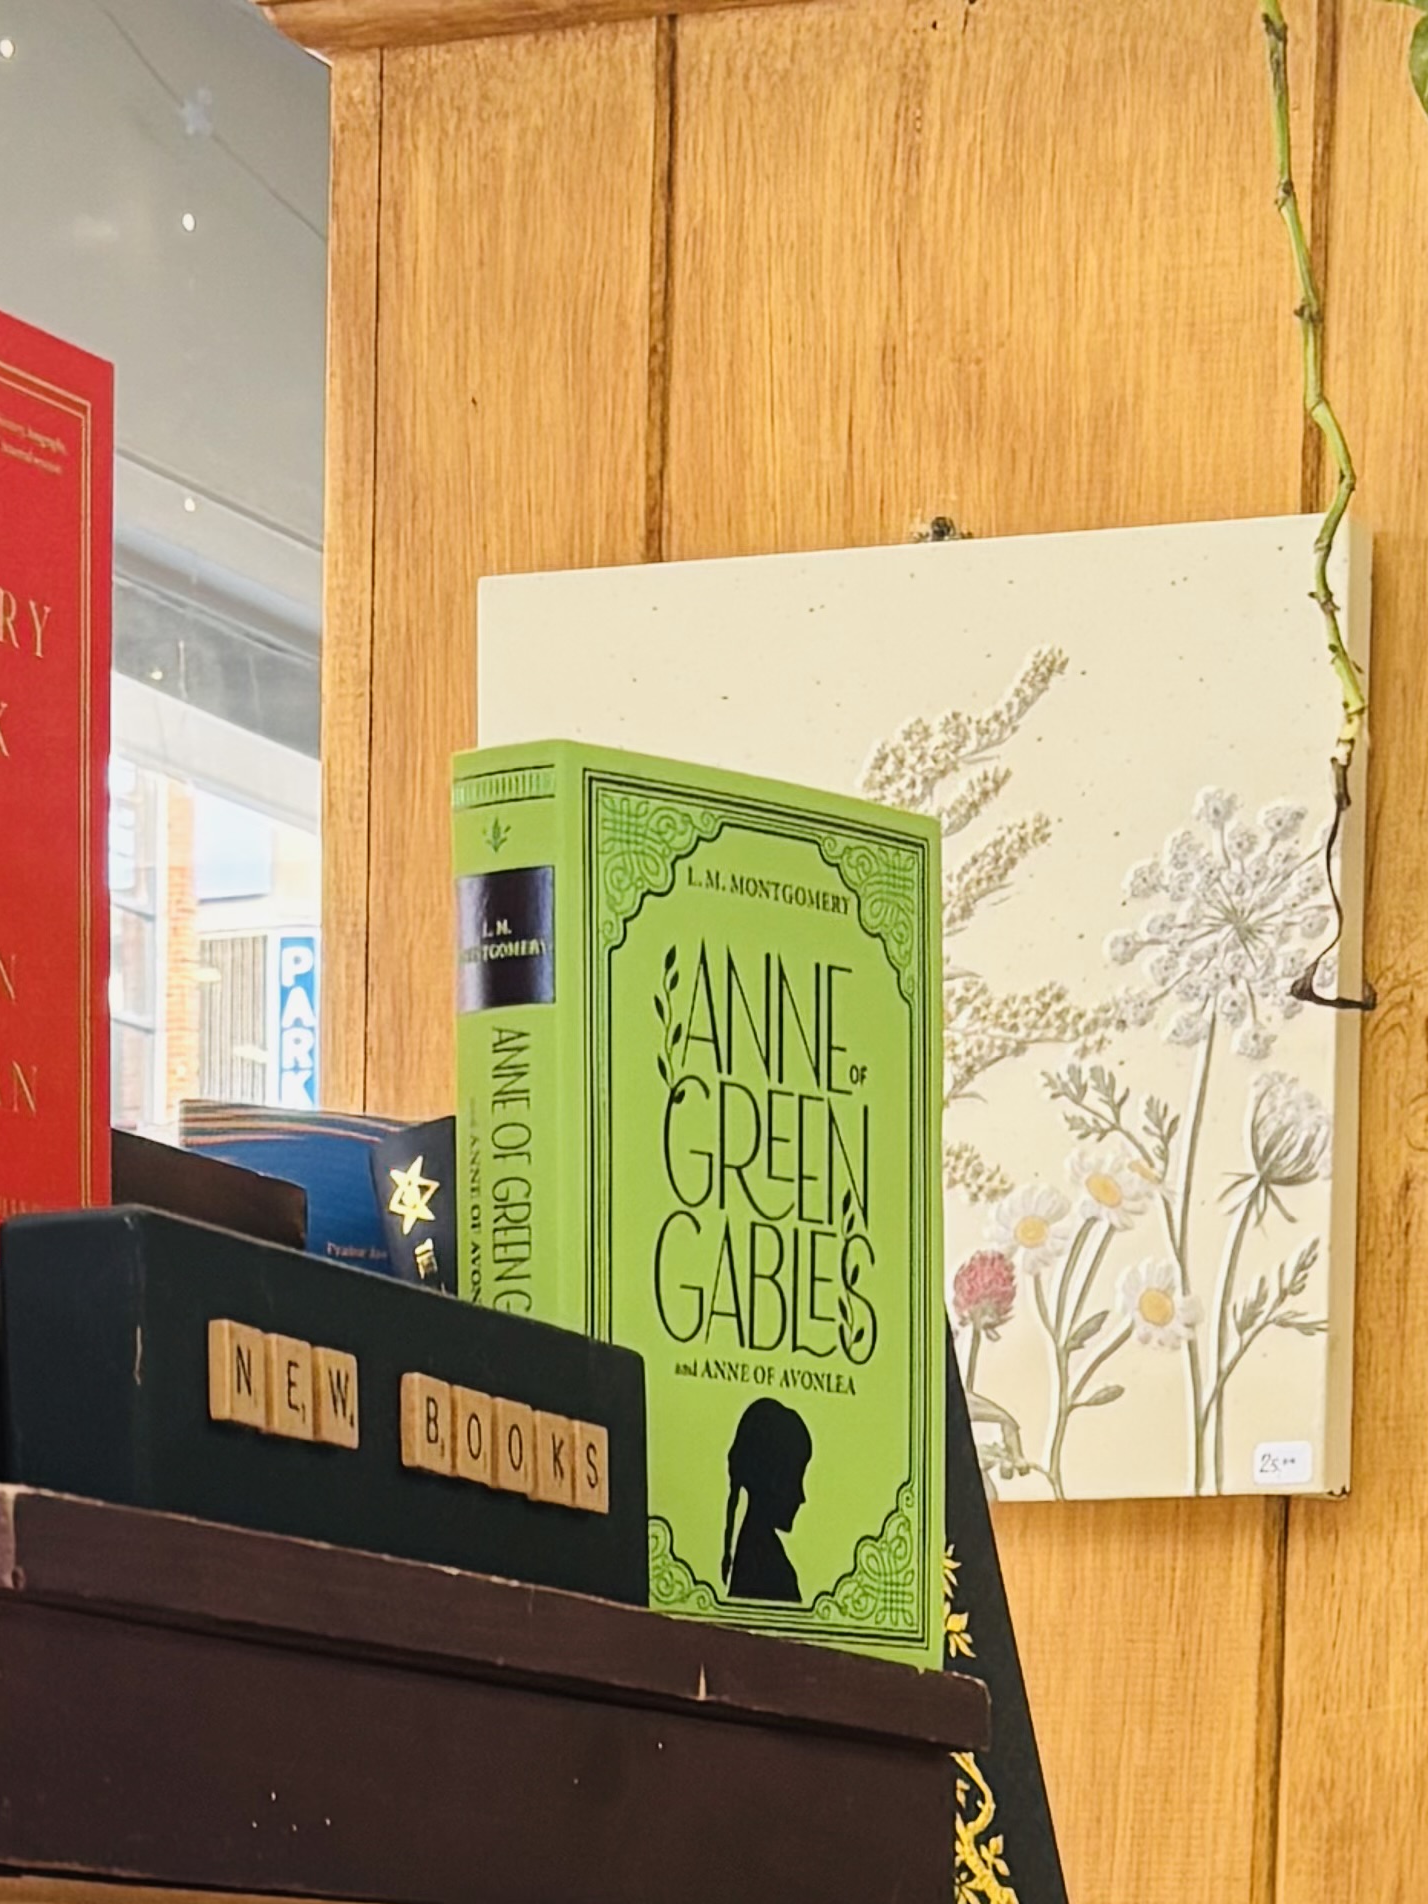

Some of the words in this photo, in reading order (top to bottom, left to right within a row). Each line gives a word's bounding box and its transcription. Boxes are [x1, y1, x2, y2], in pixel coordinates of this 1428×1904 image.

[730, 874, 851, 916] MONTGOMERY
[281, 946, 316, 1109] PARK
[491, 1026, 532, 1113] ANNE
[681, 937, 854, 1096] ANNE
[849, 1064, 868, 1086] OF
[491, 1122, 532, 1162] OF
[663, 1075, 869, 1229] GREEN
[492, 1173, 532, 1283] GREEN
[655, 1210, 877, 1365] GABLES
[236, 1345, 349, 1417] NEW
[426, 1396, 600, 1489] BOOKS
[675, 1360, 698, 1378] and
[701, 1360, 749, 1385] ANNE
[753, 1365, 775, 1386] OF
[780, 1369, 857, 1396] AVONLEA
